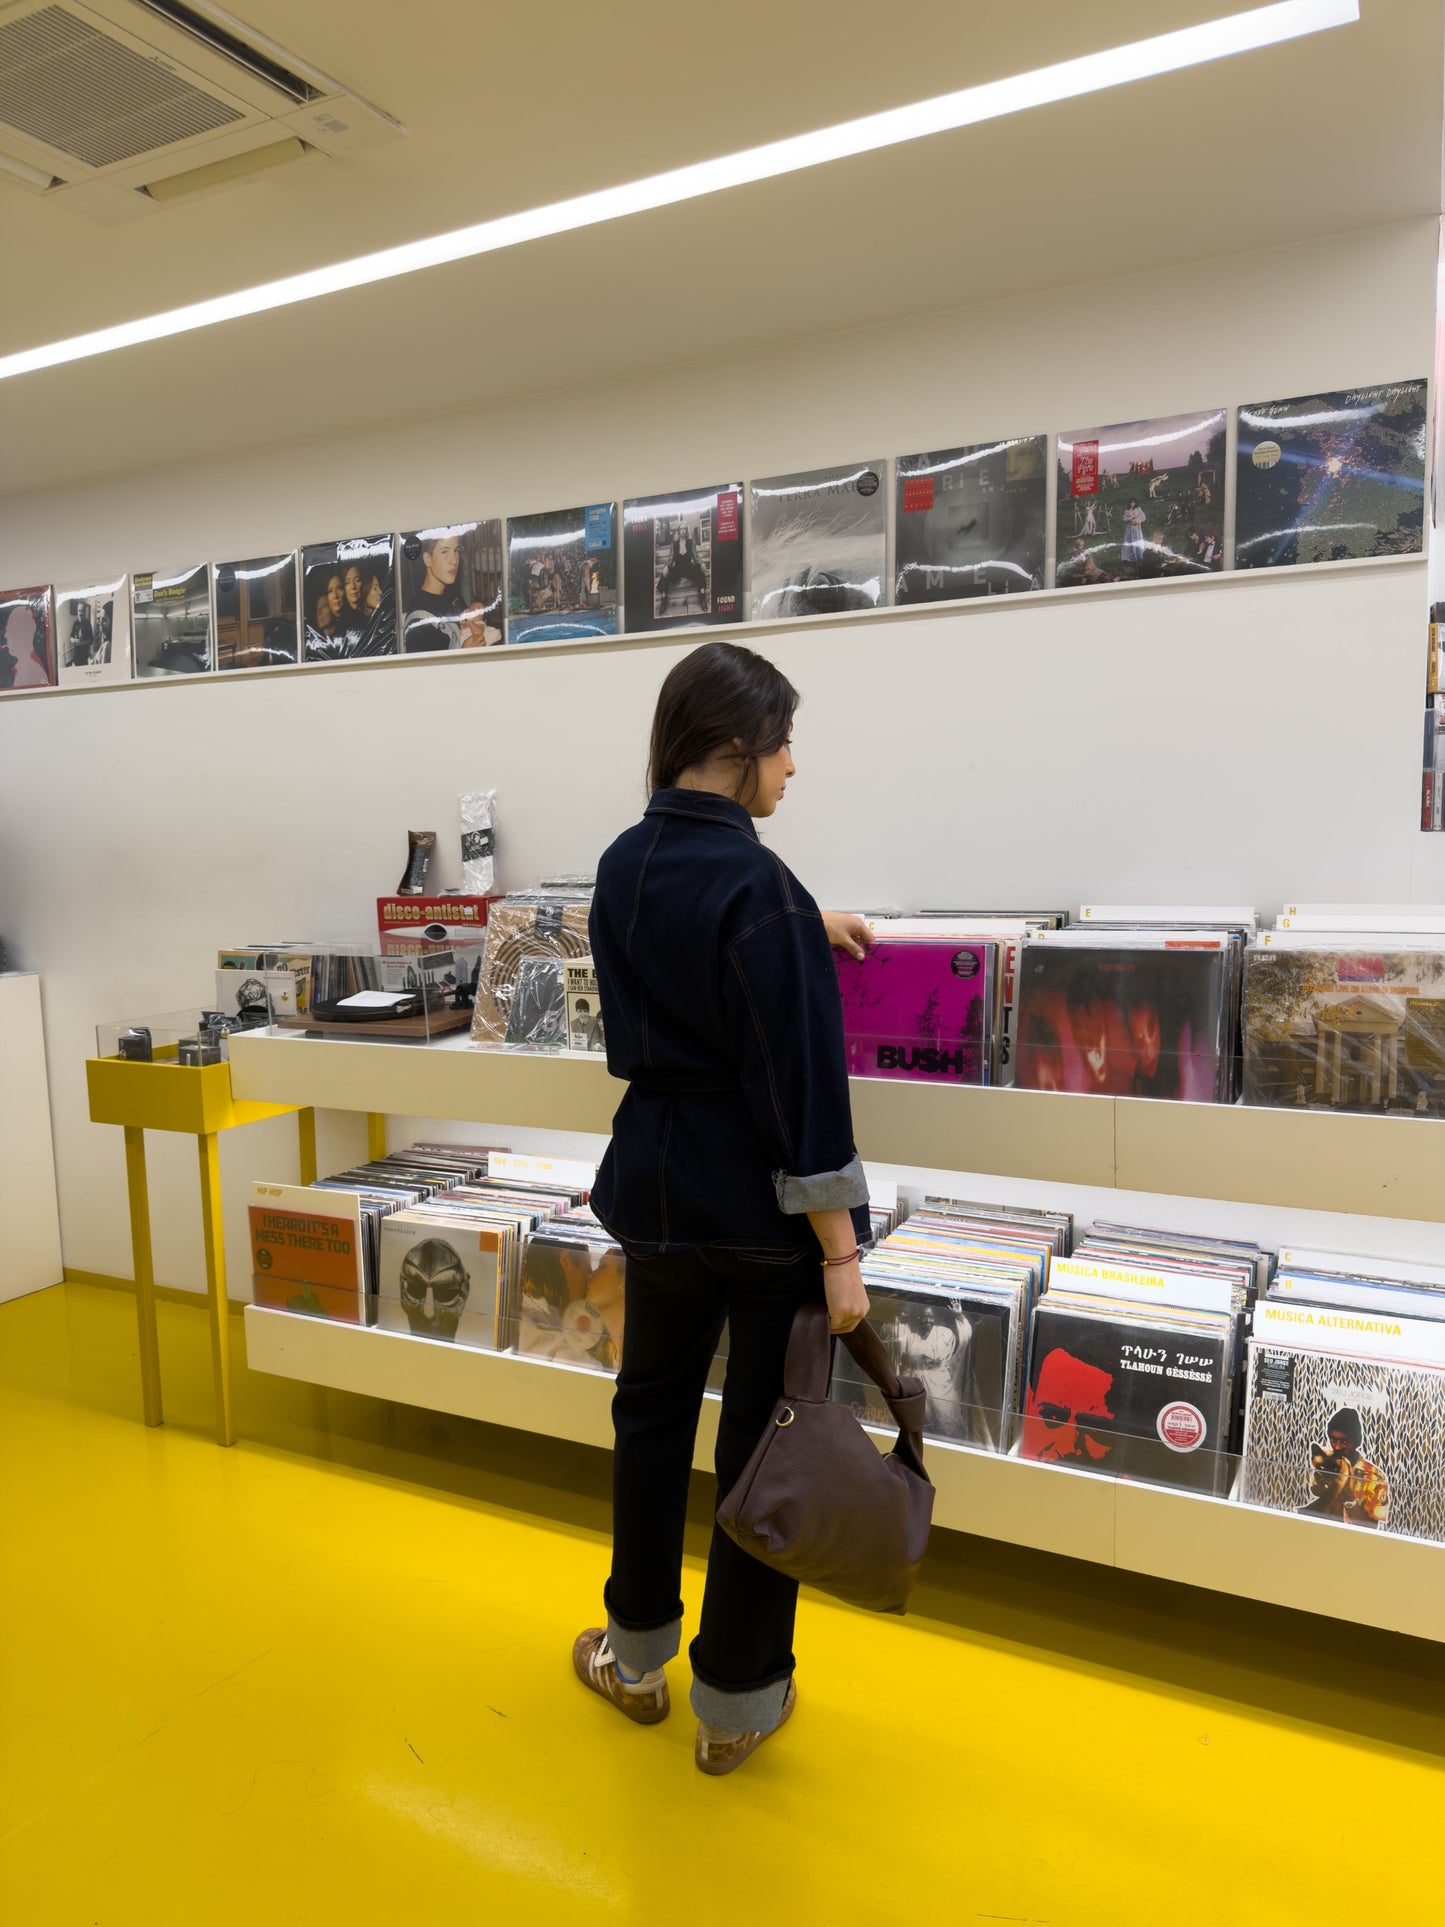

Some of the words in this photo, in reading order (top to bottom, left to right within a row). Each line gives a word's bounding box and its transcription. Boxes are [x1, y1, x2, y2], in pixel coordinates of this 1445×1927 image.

[1345, 389, 1383, 405] DAYLIGHT
[1386, 384, 1423, 404] DAYLIGHT
[383, 903, 480, 921] disco-antistt
[1085, 908, 1091, 918] E
[1289, 907, 1297, 916] H
[868, 921, 875, 931] C
[1282, 919, 1290, 929] G
[1264, 935, 1271, 946] F
[567, 968, 588, 979] THE
[877, 1044, 964, 1075] BUSH
[257, 1186, 268, 1196] HIP
[269, 1188, 282, 1198] HOP
[267, 1215, 306, 1234] HEARD
[308, 1219, 329, 1237] IT'S
[331, 1223, 339, 1238] A
[255, 1229, 285, 1246] MESS
[286, 1232, 324, 1252] THERE
[325, 1238, 351, 1255] TOO
[1285, 1252, 1291, 1262] C
[1056, 1262, 1099, 1278] MUSICA
[1101, 1268, 1165, 1288] BRASILEIRA
[1265, 1308, 1314, 1325] MUSICA
[1317, 1315, 1401, 1336] ALTERNATIVA
[1120, 1359, 1163, 1375] TLAHOUN
